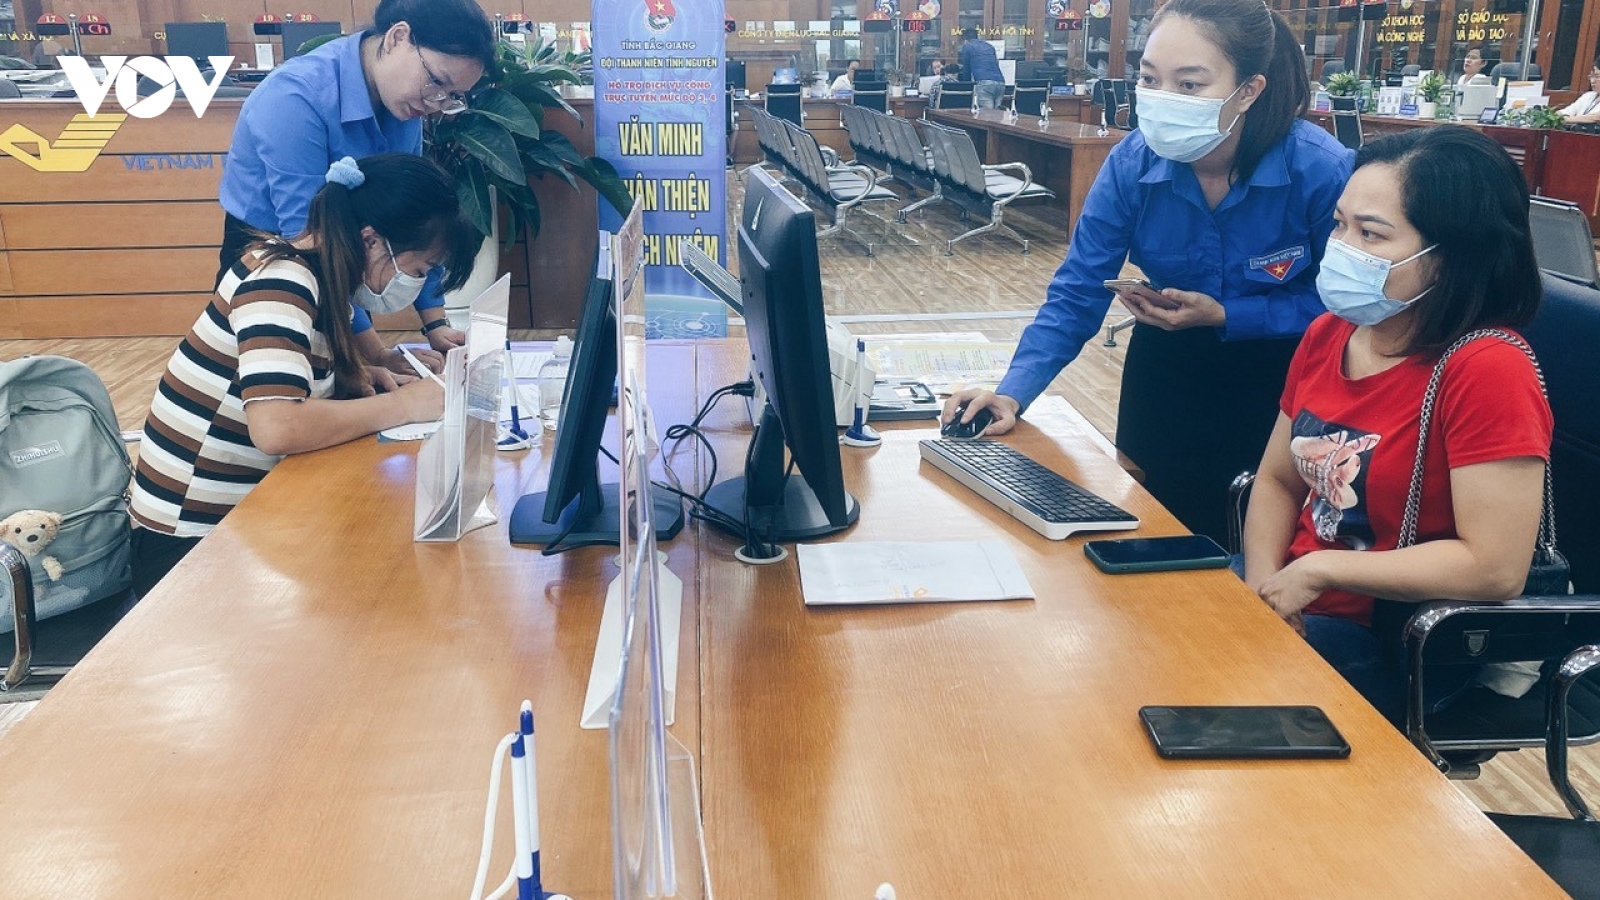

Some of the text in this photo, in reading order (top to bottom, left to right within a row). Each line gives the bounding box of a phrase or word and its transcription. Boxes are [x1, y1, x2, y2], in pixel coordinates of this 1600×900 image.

[44, 15, 56, 23] 17
[86, 14, 99, 22] 18
[262, 14, 274, 22] 19
[300, 14, 312, 22] 20
[1409, 14, 1426, 28] HỌC
[1470, 8, 1491, 24] GIÁO
[1385, 29, 1406, 42] CÔNG
[1406, 28, 1426, 44] NGHỆ
[1456, 26, 1505, 42] VÀ ĐÀO TẠO
[644, 36, 664, 50] BẮC
[665, 41, 697, 50] GIANG
[616, 57, 642, 67] THANH
[665, 55, 684, 68] TÌNH
[645, 81, 666, 91] DỊCH
[669, 81, 682, 91] VỤ
[684, 79, 711, 90] CÔNG
[618, 115, 703, 156] VĂN MINH
[119, 154, 214, 170] VIETNAM
[661, 171, 710, 219] THIỆN
